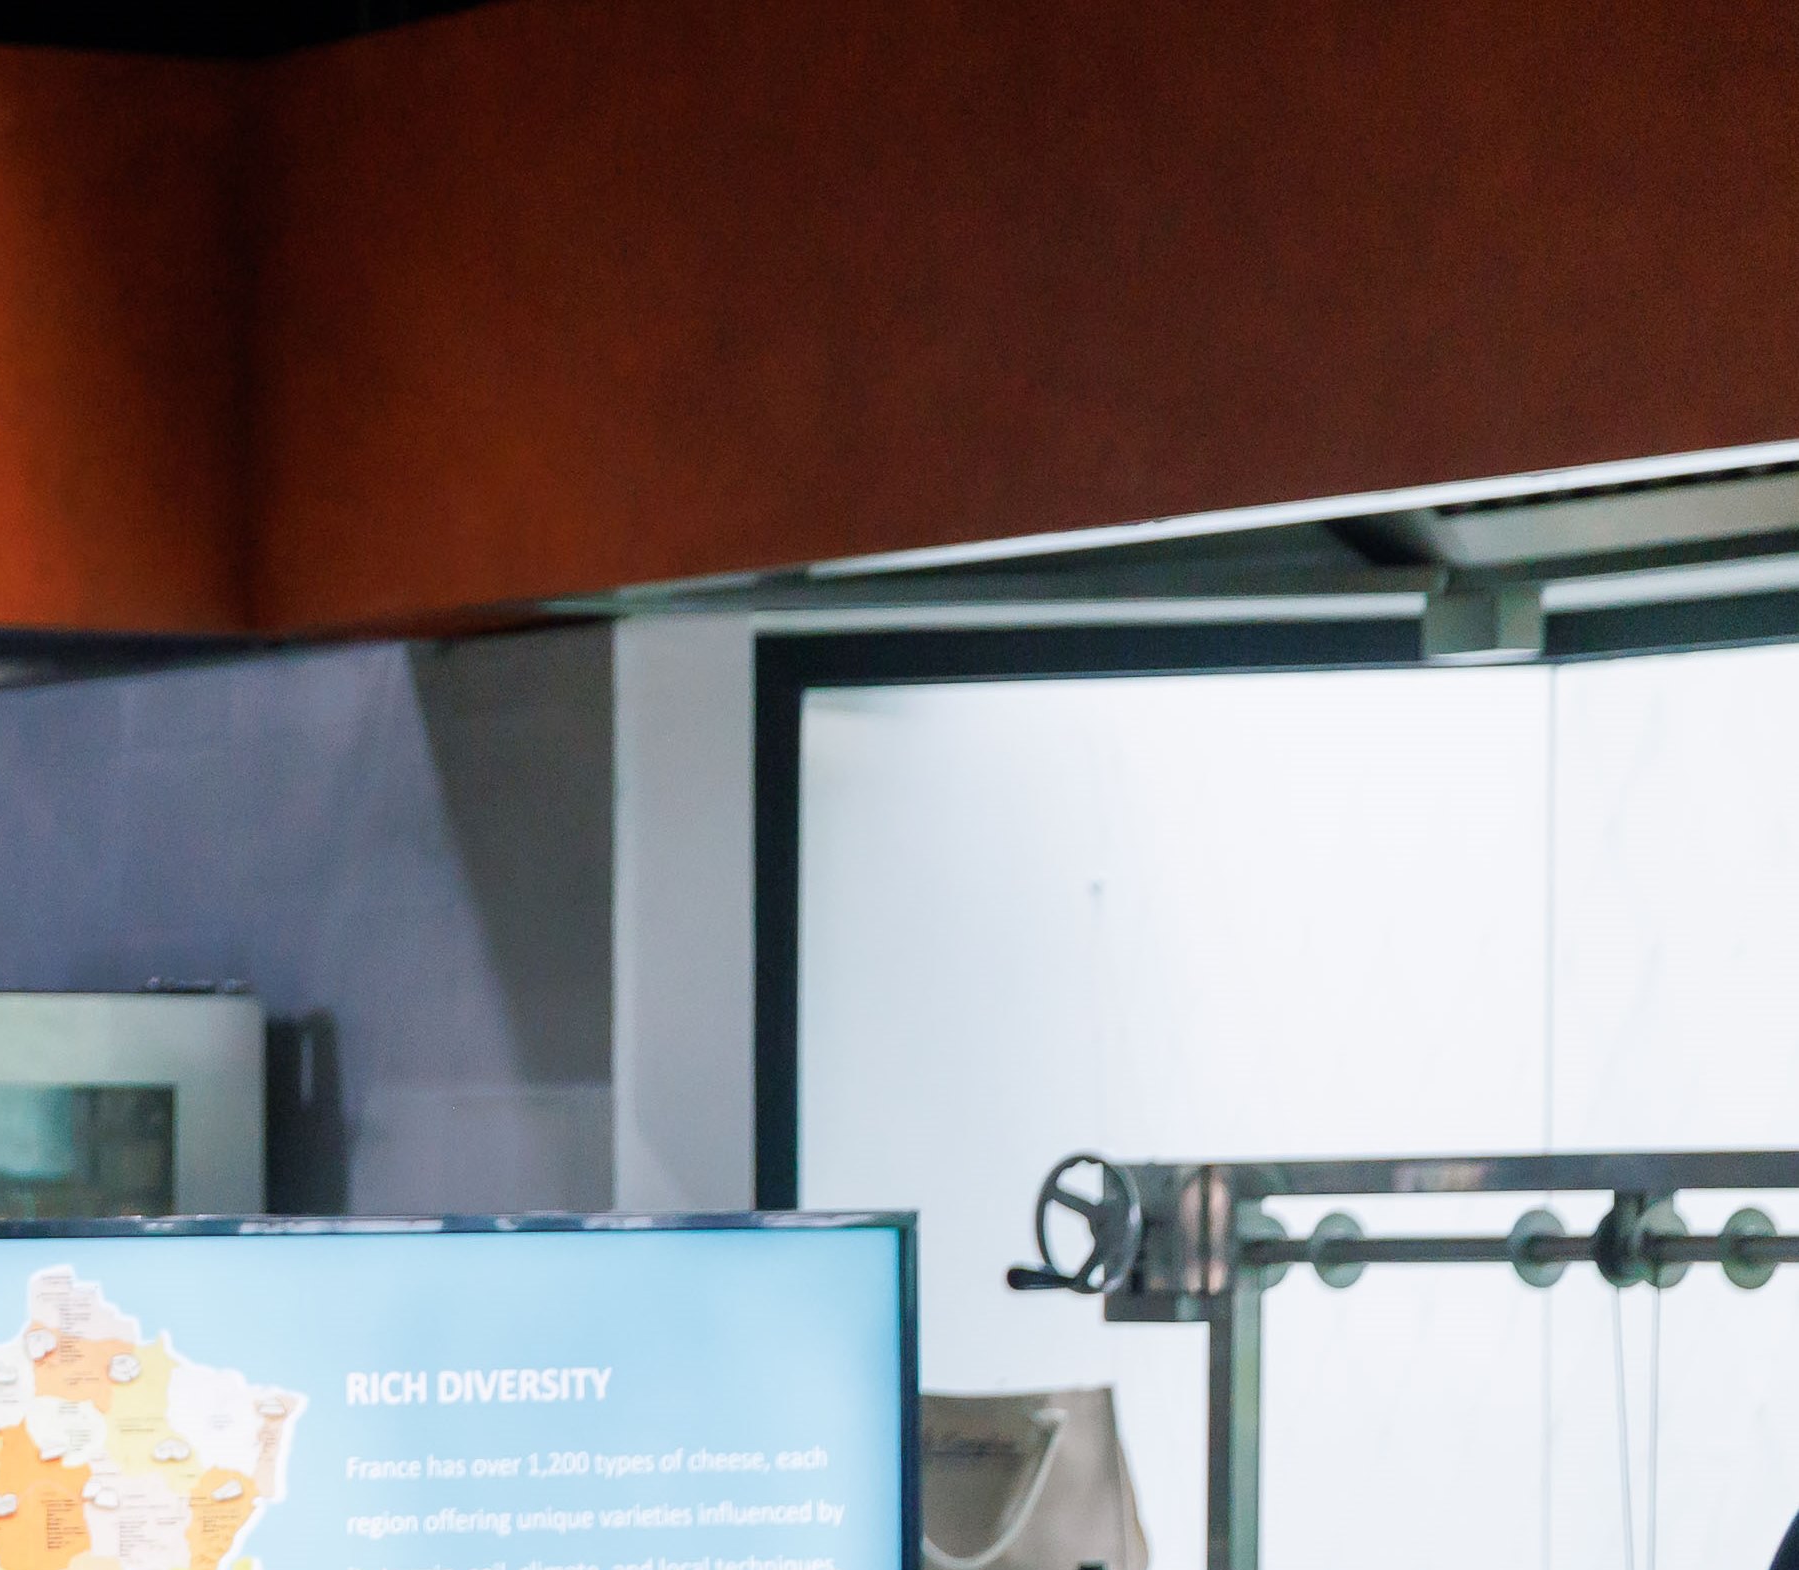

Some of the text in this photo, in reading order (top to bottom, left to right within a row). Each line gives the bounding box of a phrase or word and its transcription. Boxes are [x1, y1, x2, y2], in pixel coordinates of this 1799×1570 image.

[346, 1367, 612, 1406] RICH DIVERSITY
[345, 1445, 828, 1479] France has over 1,200 types of cheese, each
[346, 1499, 845, 1539] region offering unique varieties influenced by
